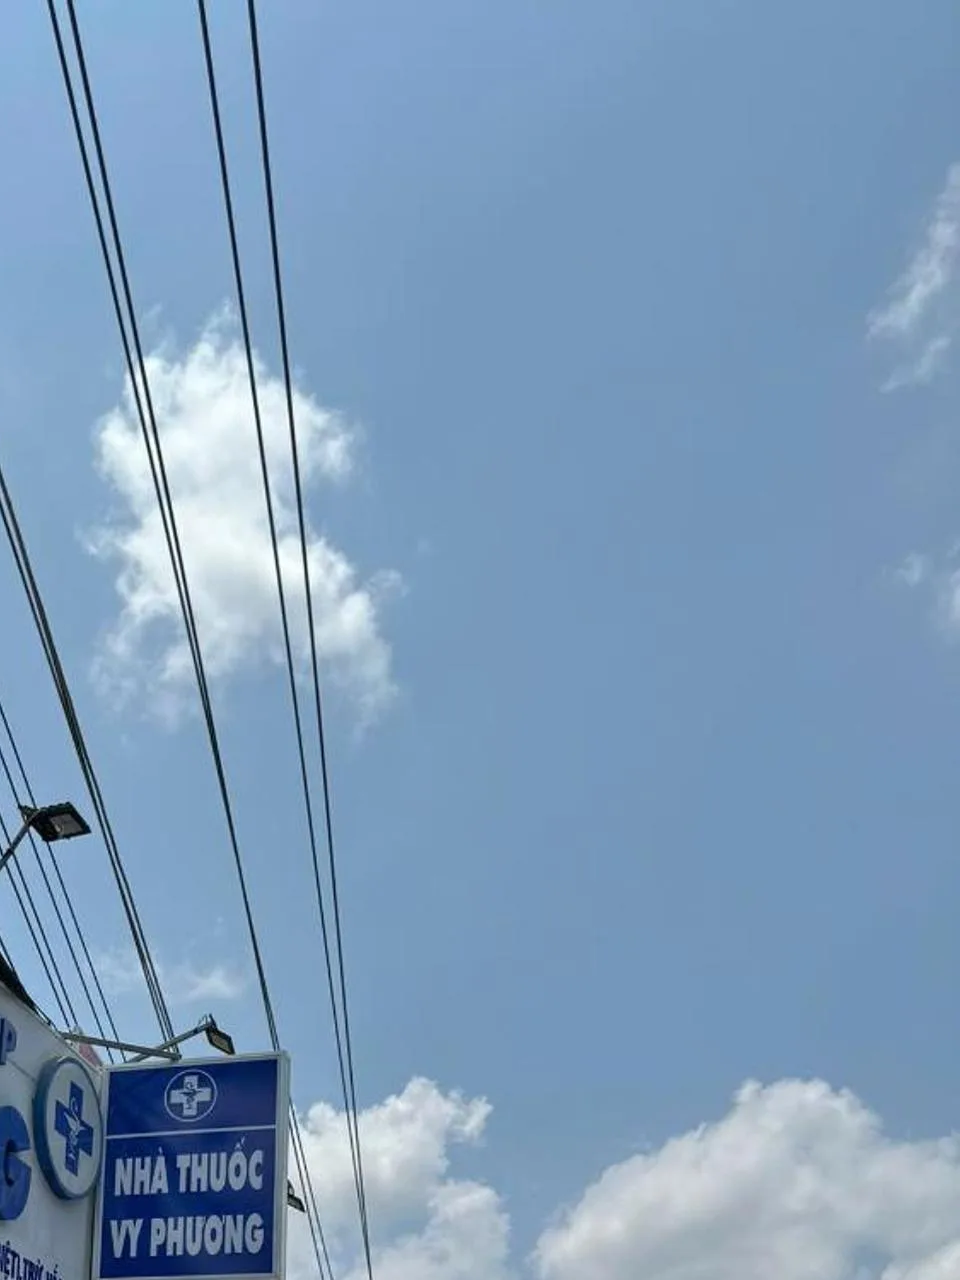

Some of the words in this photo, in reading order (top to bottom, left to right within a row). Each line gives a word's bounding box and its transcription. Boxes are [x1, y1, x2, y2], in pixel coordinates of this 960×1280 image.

[114, 1146, 169, 1197] NHÀ
[177, 1135, 263, 1194] THUỐC
[109, 1217, 144, 1259] VY
[150, 1212, 265, 1258] PHƯƠNG
